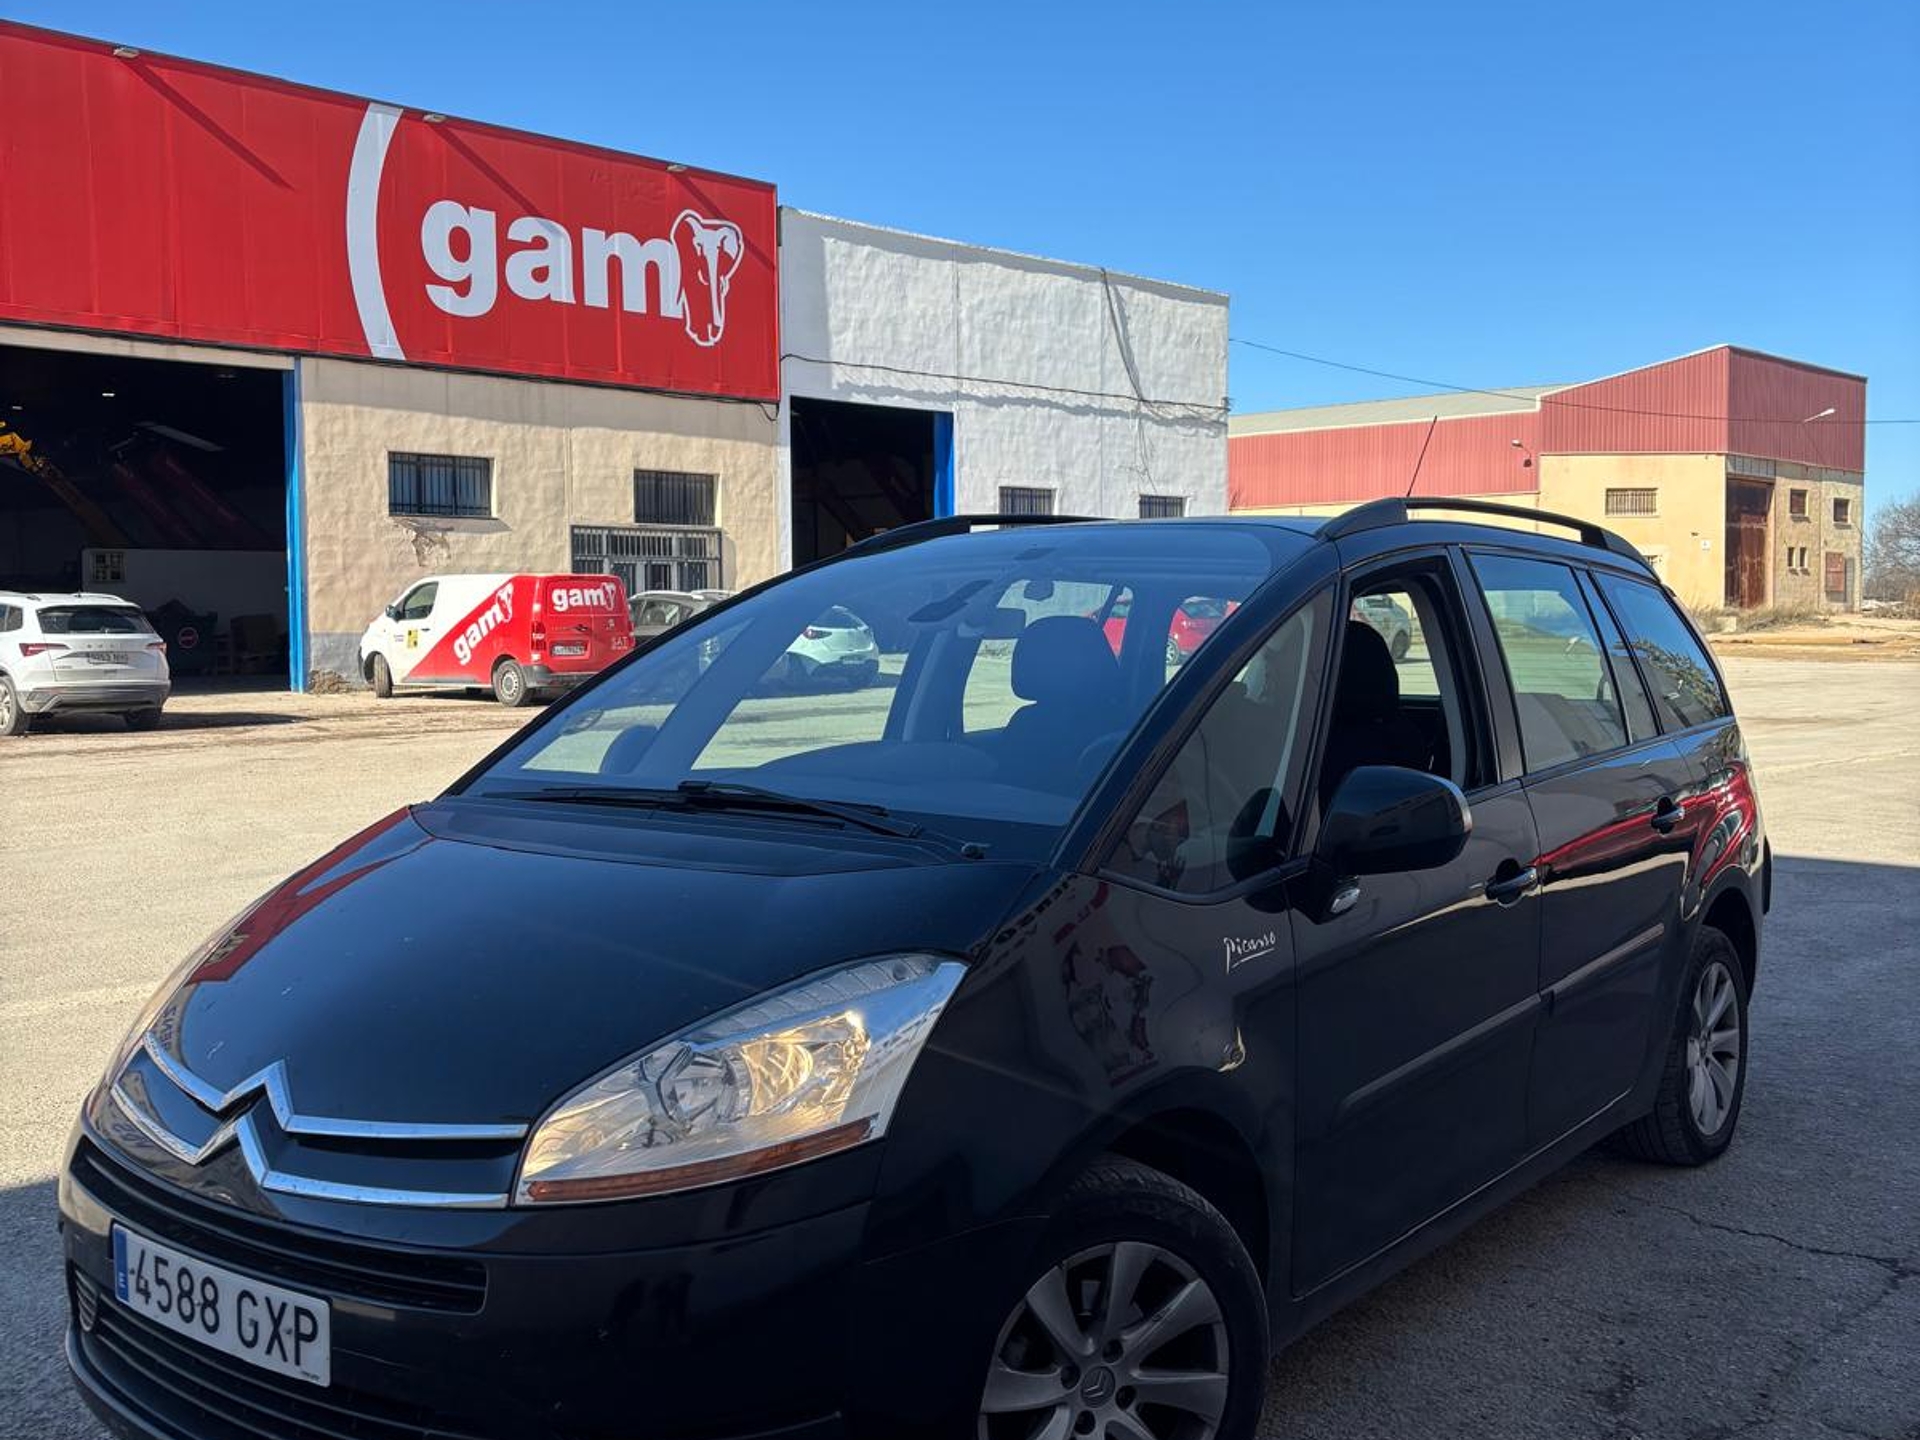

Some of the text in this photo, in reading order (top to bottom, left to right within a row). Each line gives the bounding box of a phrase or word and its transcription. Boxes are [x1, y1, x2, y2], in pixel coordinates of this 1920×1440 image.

[421, 199, 684, 318] gam
[453, 603, 504, 665] gam
[551, 588, 606, 612] gam
[135, 1249, 219, 1333] 4588
[237, 1290, 318, 1366] GXP
